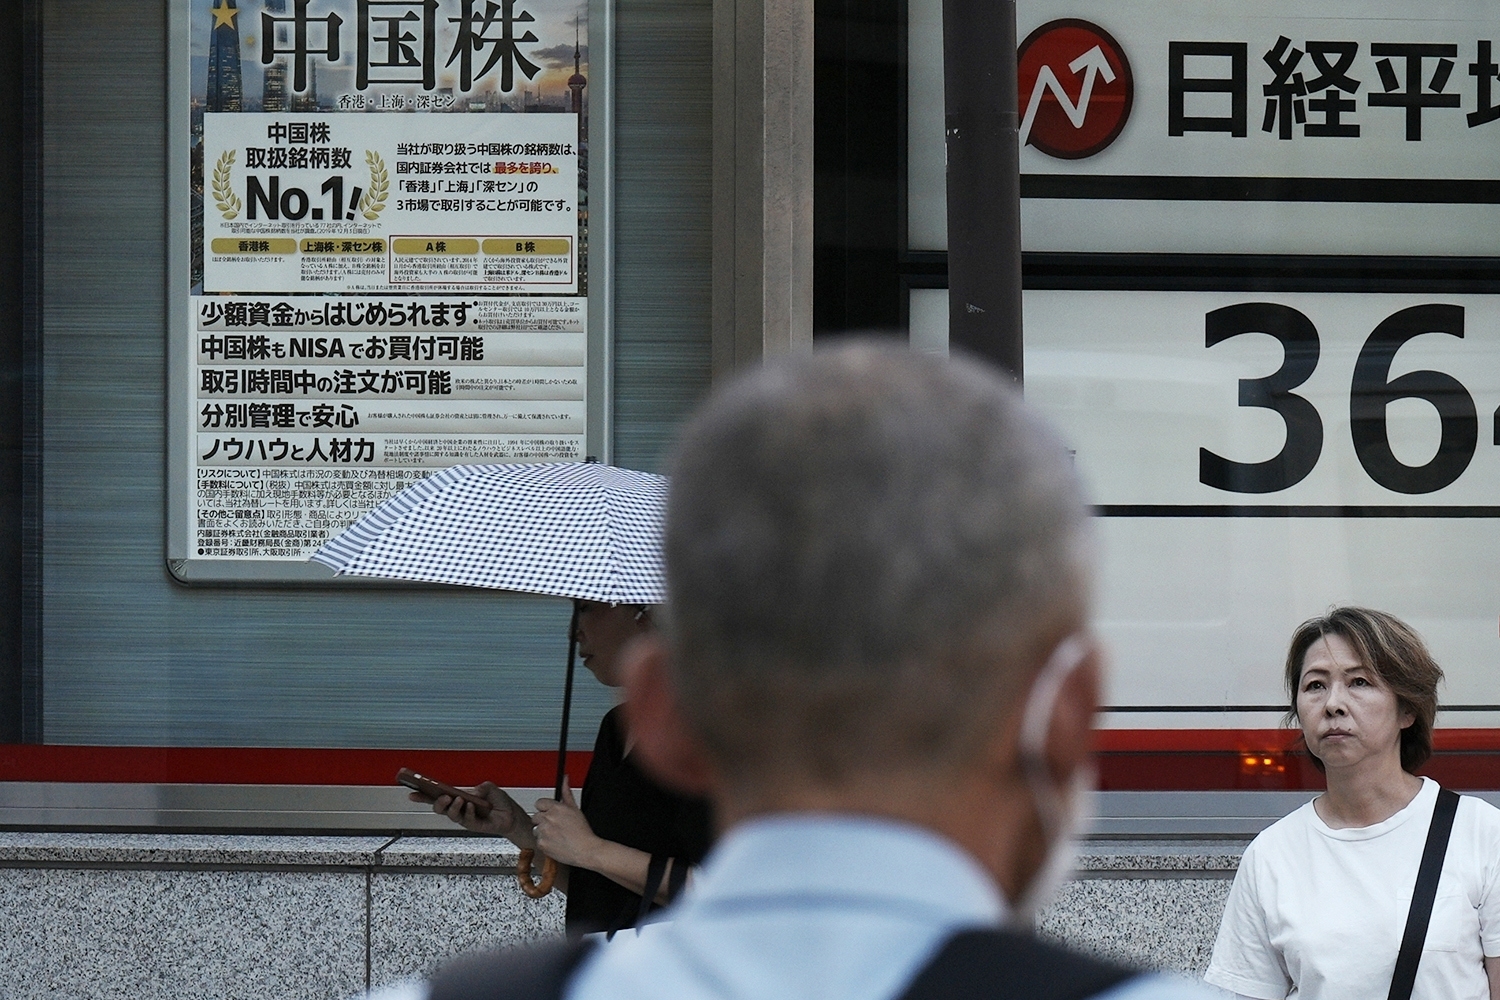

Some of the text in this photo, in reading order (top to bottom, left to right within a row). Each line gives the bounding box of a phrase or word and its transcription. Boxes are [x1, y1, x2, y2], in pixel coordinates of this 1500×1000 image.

[261, 0, 541, 93] 中国株
[338, 94, 456, 109] 香港・上海・深セン
[267, 121, 331, 144] 中国株
[246, 147, 352, 169] 取扱銘柄数
[397, 143, 577, 156] 当社が取り扱う中国株の銘柄数は、
[246, 176, 362, 220] No.1!
[238, 241, 270, 252] 香港株
[303, 241, 383, 252] 上海株・深セン株
[201, 302, 472, 327] 少額資金からはじめられます
[201, 369, 451, 395] 取引時間中の注文が可能
[201, 403, 359, 428] 分別管理で安心
[201, 437, 375, 462] ノウハウと人材力
